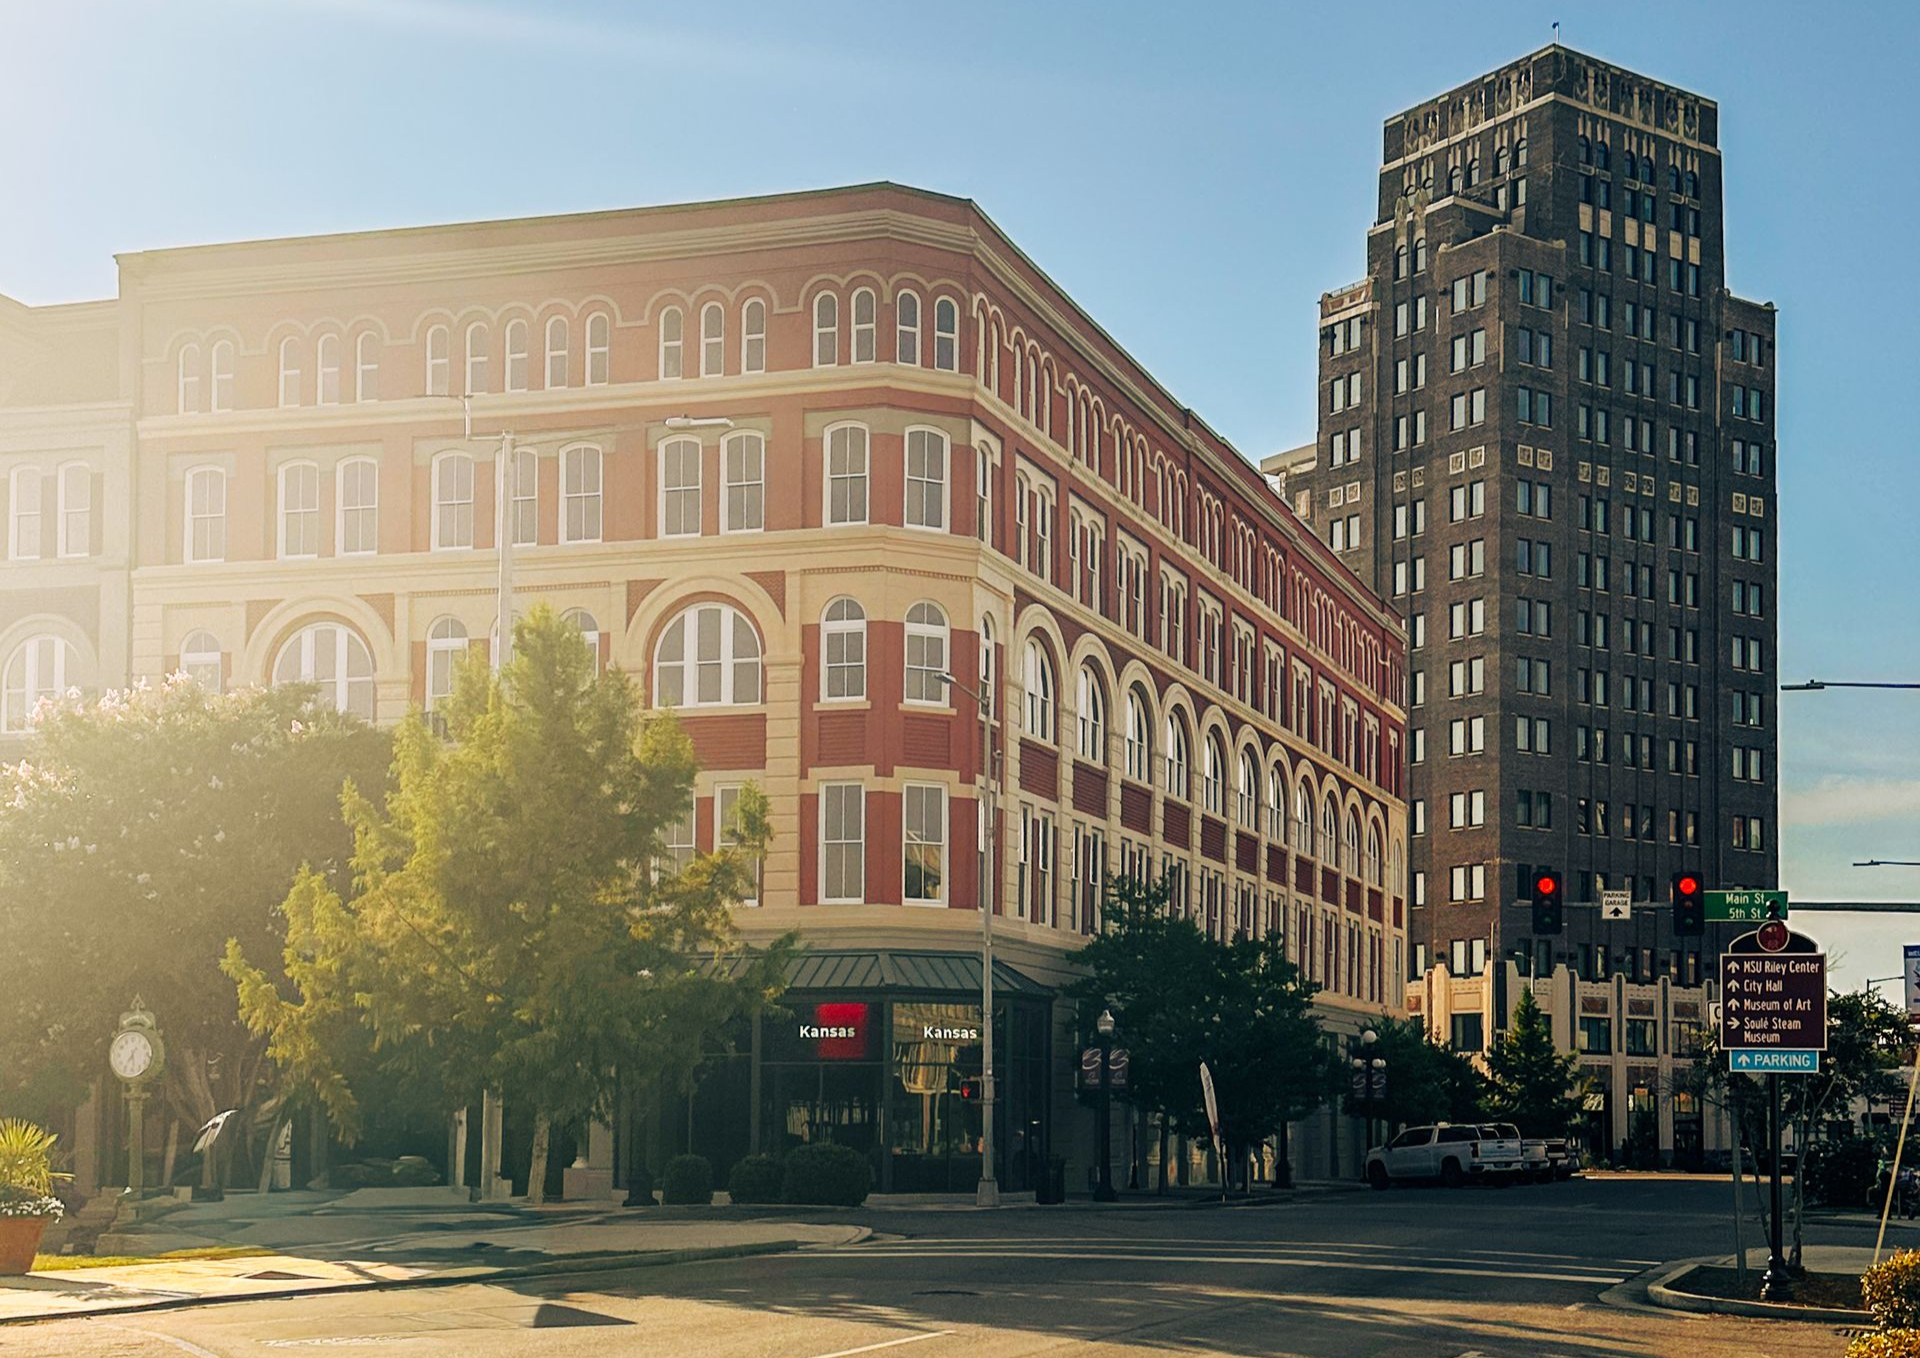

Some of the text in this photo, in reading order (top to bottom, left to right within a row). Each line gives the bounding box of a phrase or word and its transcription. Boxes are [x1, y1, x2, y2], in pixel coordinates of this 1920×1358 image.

[1725, 892, 1765, 904] Main St
[1729, 908, 1761, 919] 5th St
[1743, 961, 1820, 976] MSU Riley Center
[1743, 980, 1783, 995] City Hall
[1743, 998, 1812, 1011] Museum of Art
[1772, 1017, 1802, 1030] Steam
[800, 1025, 856, 1038] Kansas
[923, 1026, 978, 1039] Kansas
[1743, 1031, 1781, 1043] Museum
[1754, 1054, 1811, 1067] PARKING
